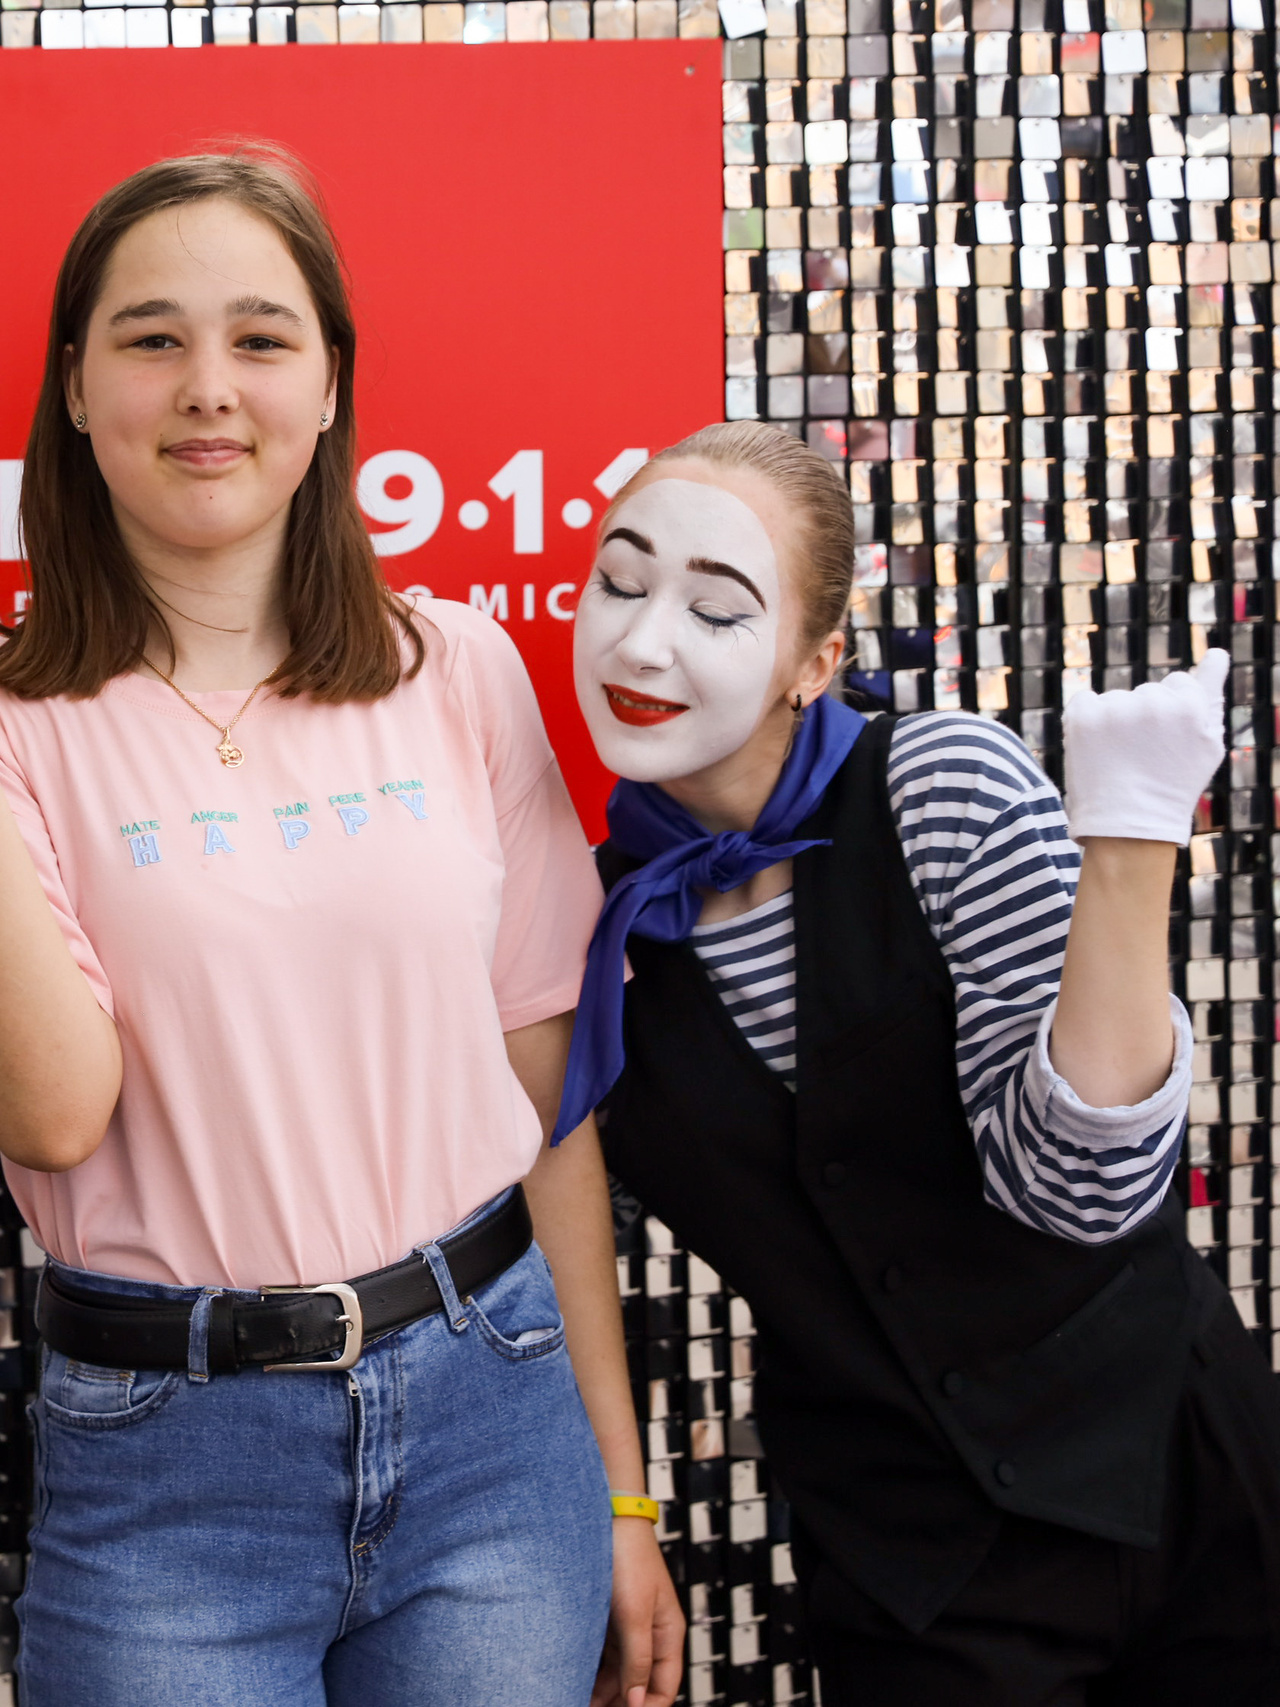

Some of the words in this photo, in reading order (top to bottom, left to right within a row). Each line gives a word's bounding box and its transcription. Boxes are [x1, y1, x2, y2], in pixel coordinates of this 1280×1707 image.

[469, 582, 577, 621] МІС
[120, 820, 160, 837] HATE
[191, 810, 239, 824] ANGER
[273, 802, 310, 819] PAIN
[377, 779, 425, 796] YEARN
